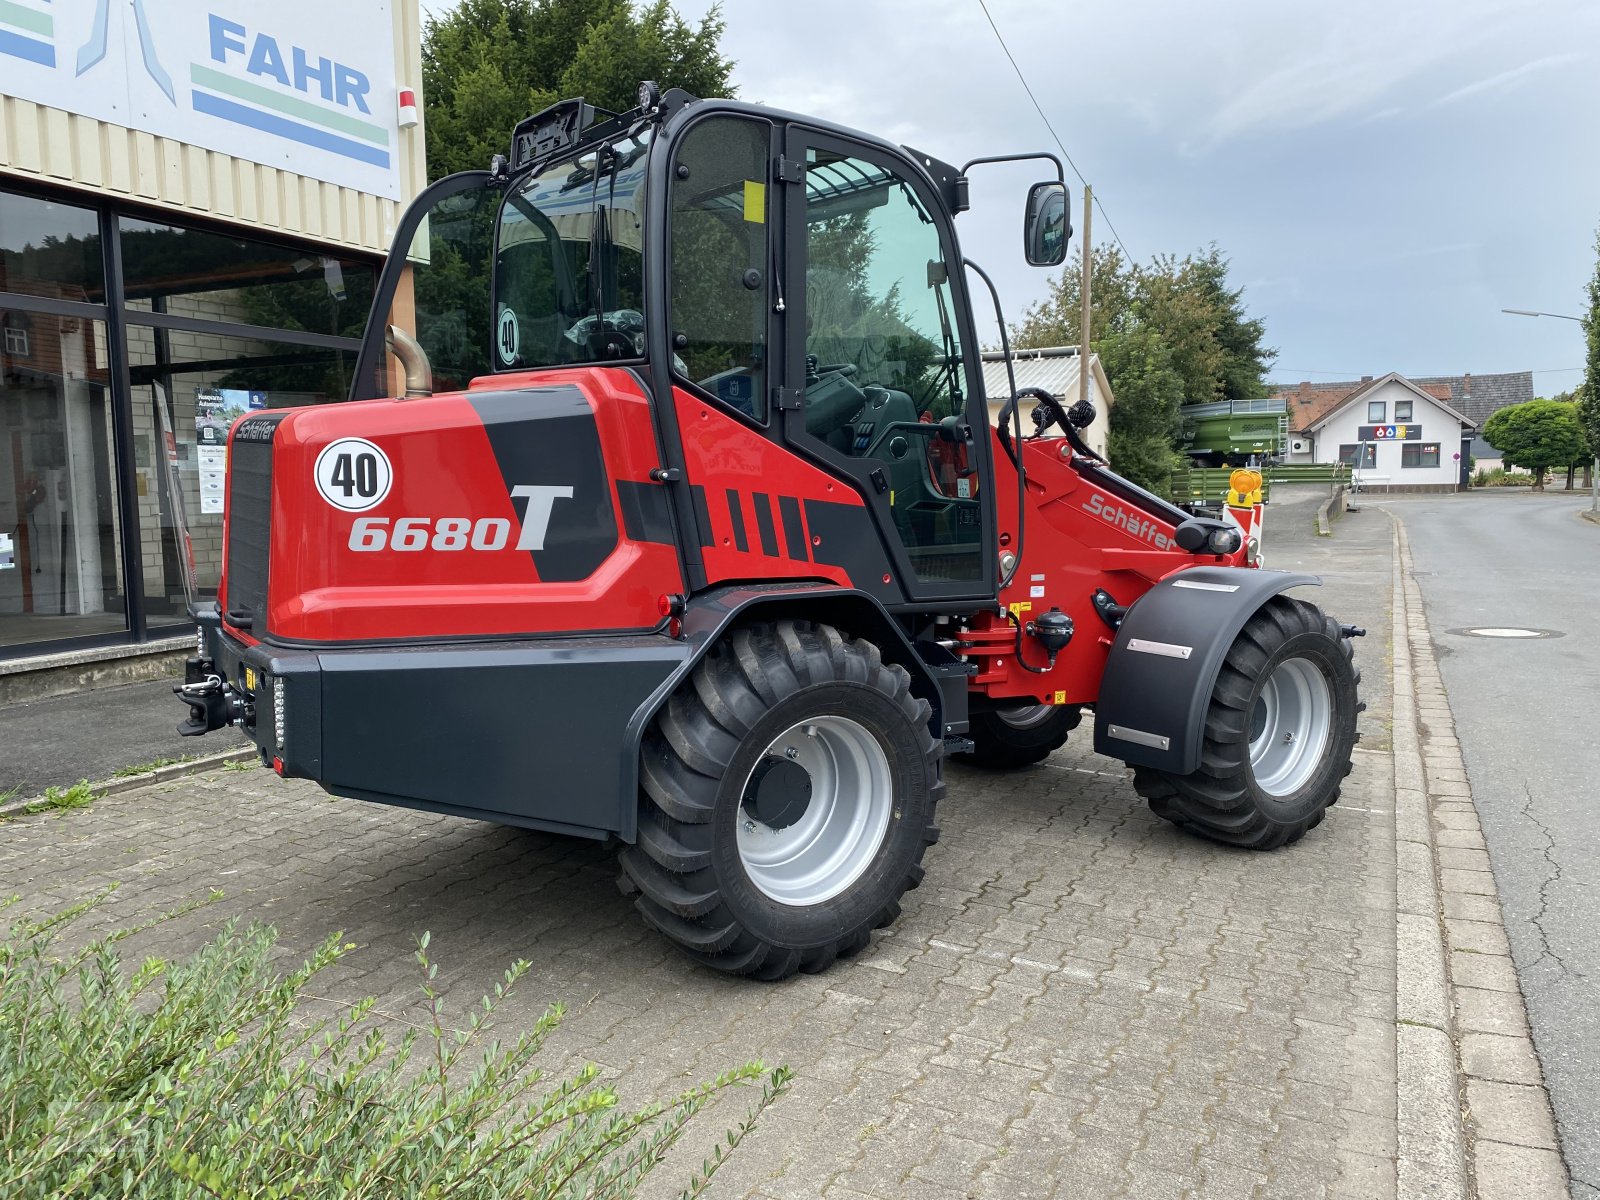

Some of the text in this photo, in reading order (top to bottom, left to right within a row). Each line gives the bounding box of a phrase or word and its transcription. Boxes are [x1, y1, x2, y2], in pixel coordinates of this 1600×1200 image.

[208, 13, 371, 115] FAHR
[502, 319, 514, 353] 40
[236, 420, 276, 439] Schäffer
[331, 453, 377, 497] 40
[1081, 493, 1178, 551] Schäffer
